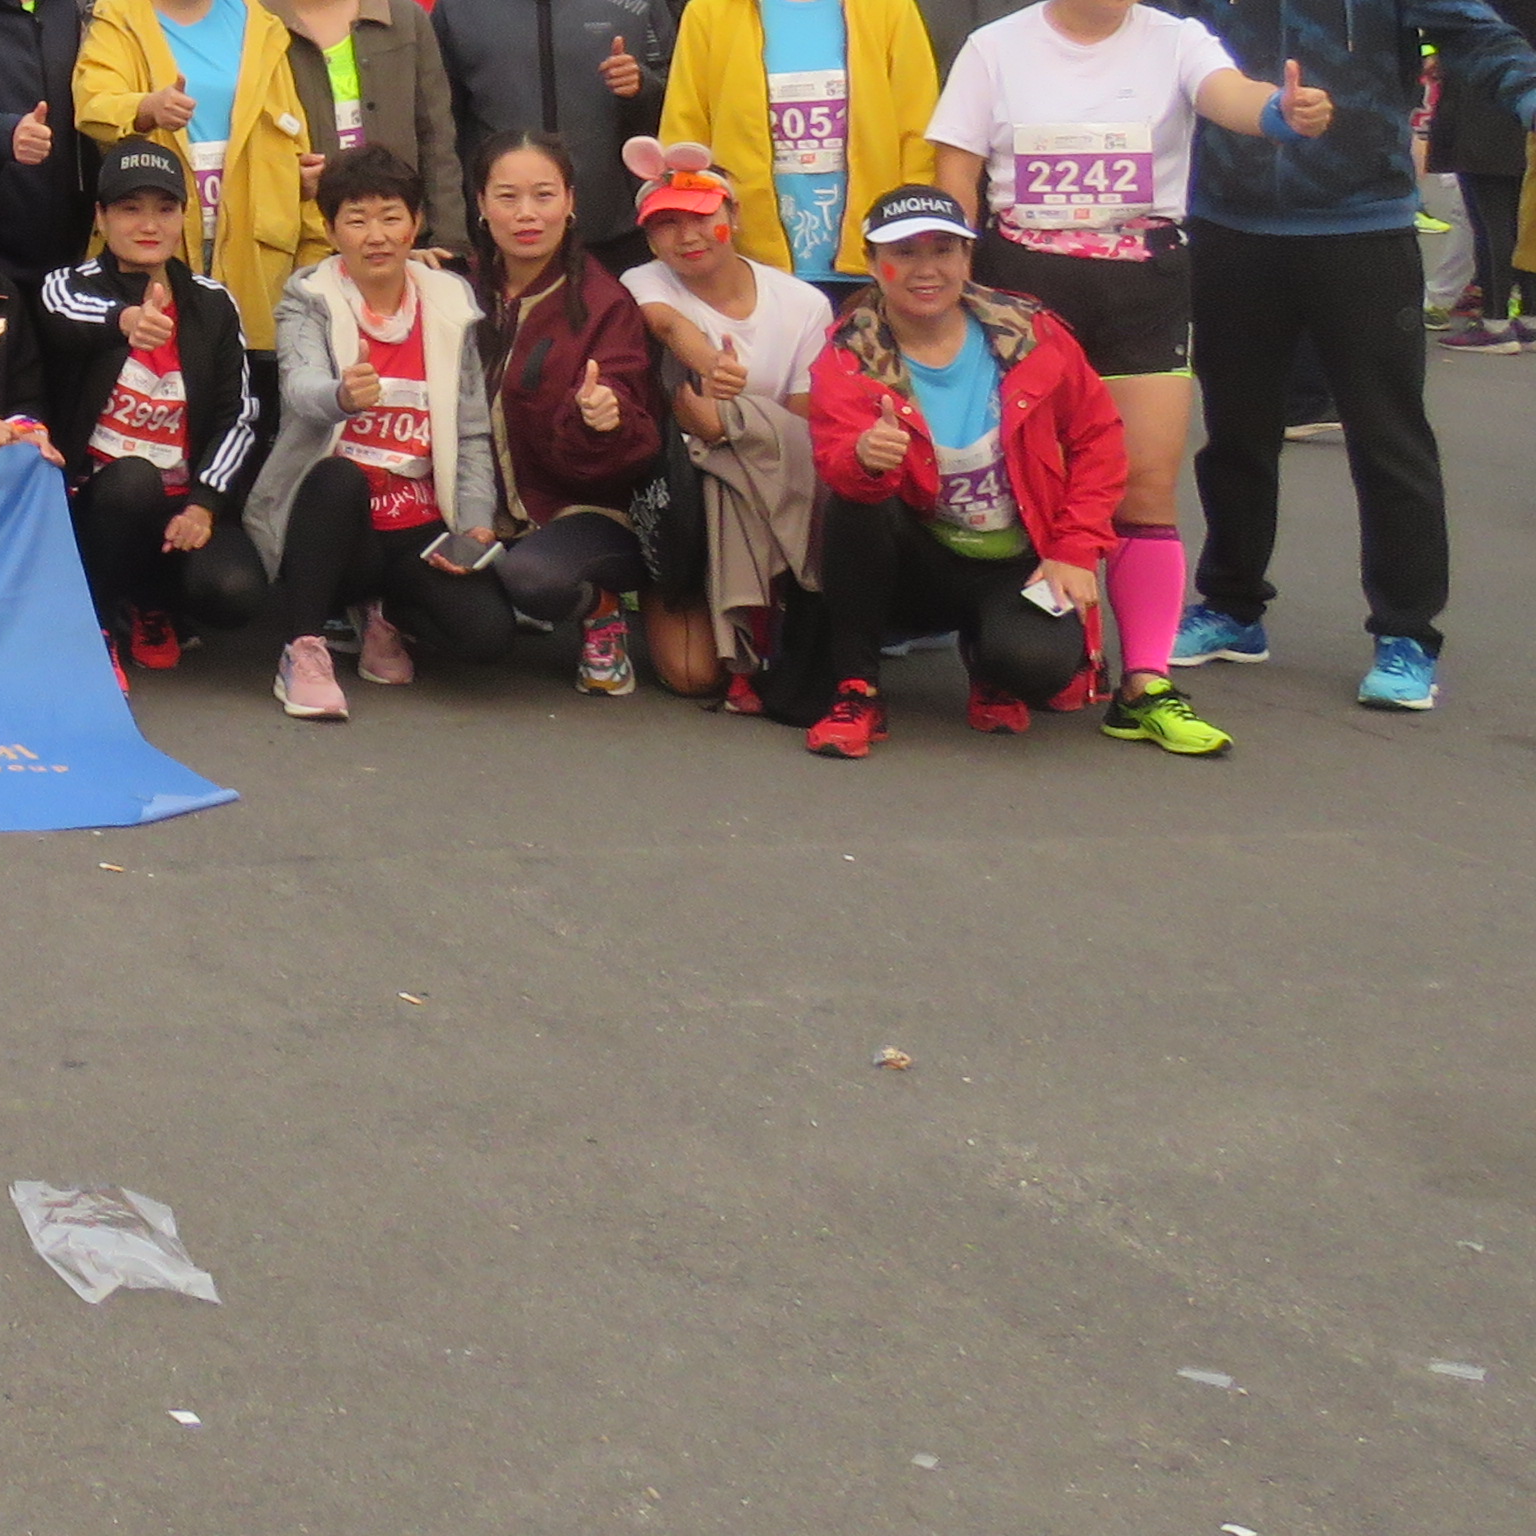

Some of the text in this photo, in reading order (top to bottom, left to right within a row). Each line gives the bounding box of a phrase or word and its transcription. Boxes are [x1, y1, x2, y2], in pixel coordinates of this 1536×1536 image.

[1027, 159, 1139, 192] 2242
[883, 198, 952, 218] KMQHAT
[351, 411, 430, 446] 5104
